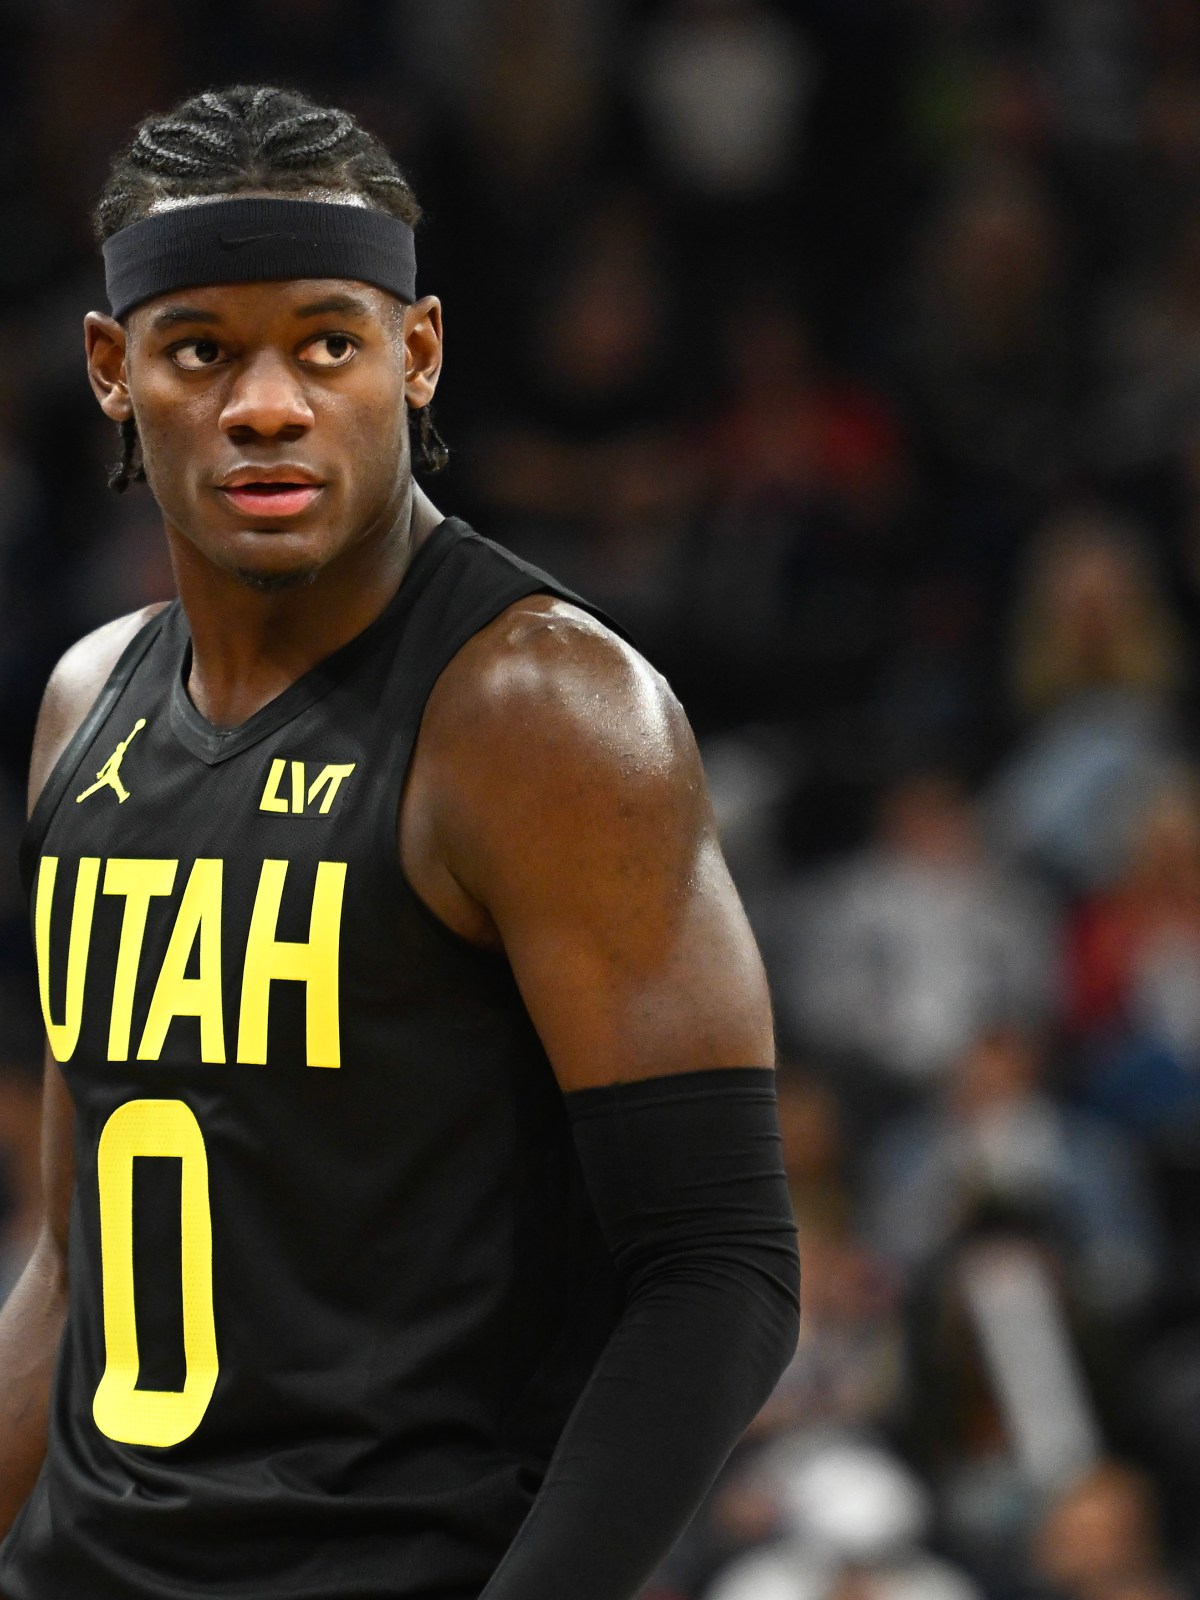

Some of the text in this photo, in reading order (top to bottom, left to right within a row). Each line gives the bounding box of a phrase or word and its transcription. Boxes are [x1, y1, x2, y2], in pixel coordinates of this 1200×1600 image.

[259, 758, 357, 814] LVT
[35, 856, 348, 1069] UTAH
[92, 1098, 220, 1448] 0
